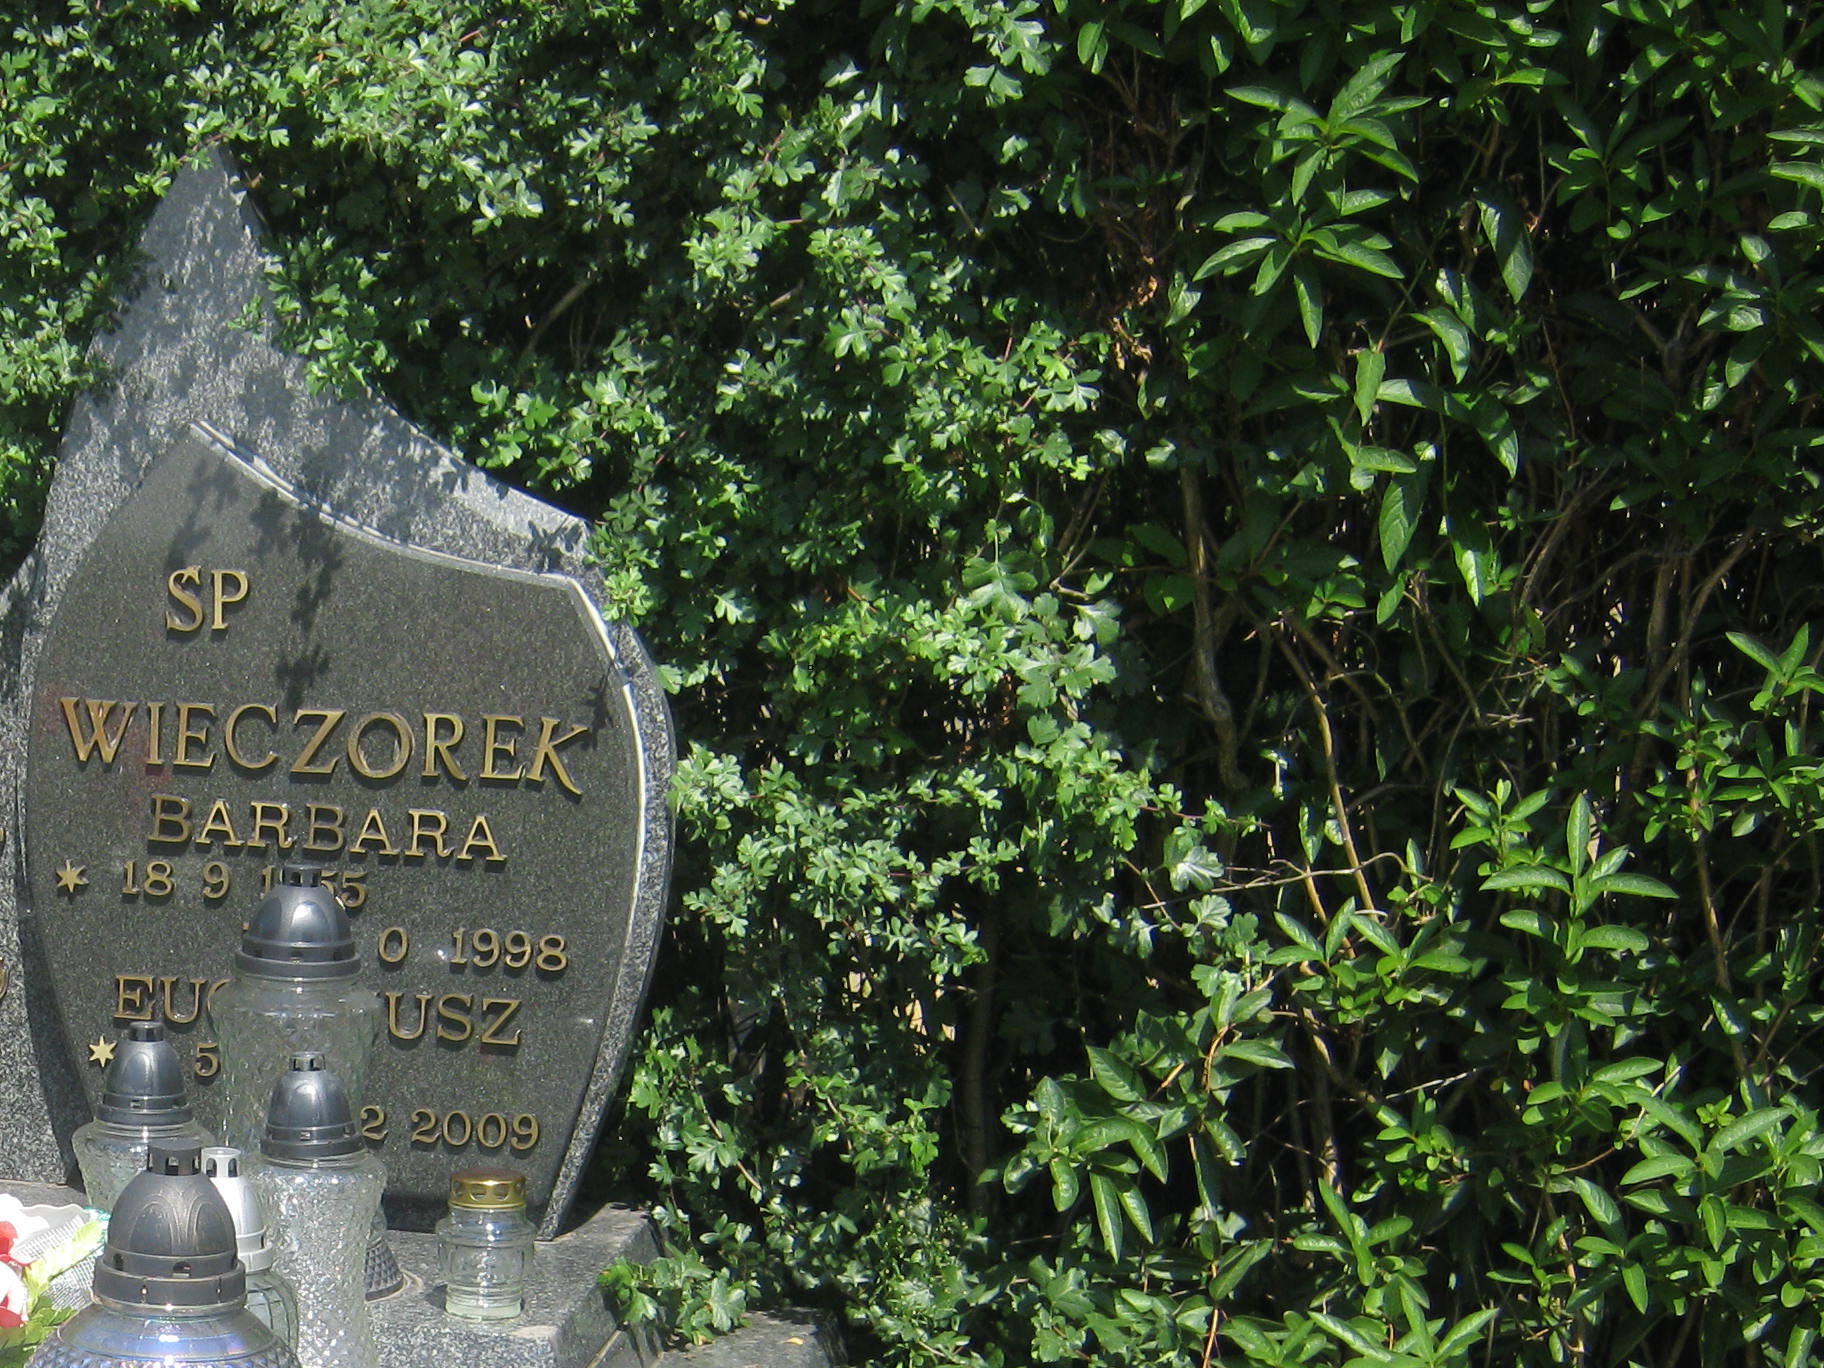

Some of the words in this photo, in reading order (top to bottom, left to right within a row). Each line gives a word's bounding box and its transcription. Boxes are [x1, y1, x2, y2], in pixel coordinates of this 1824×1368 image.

[61, 697, 588, 795] WIECZOREK
[147, 795, 506, 861] BARBARA
[122, 861, 174, 896] 18
[202, 861, 230, 898] 9
[450, 928, 567, 971] 1998
[411, 1109, 539, 1149] 2009
